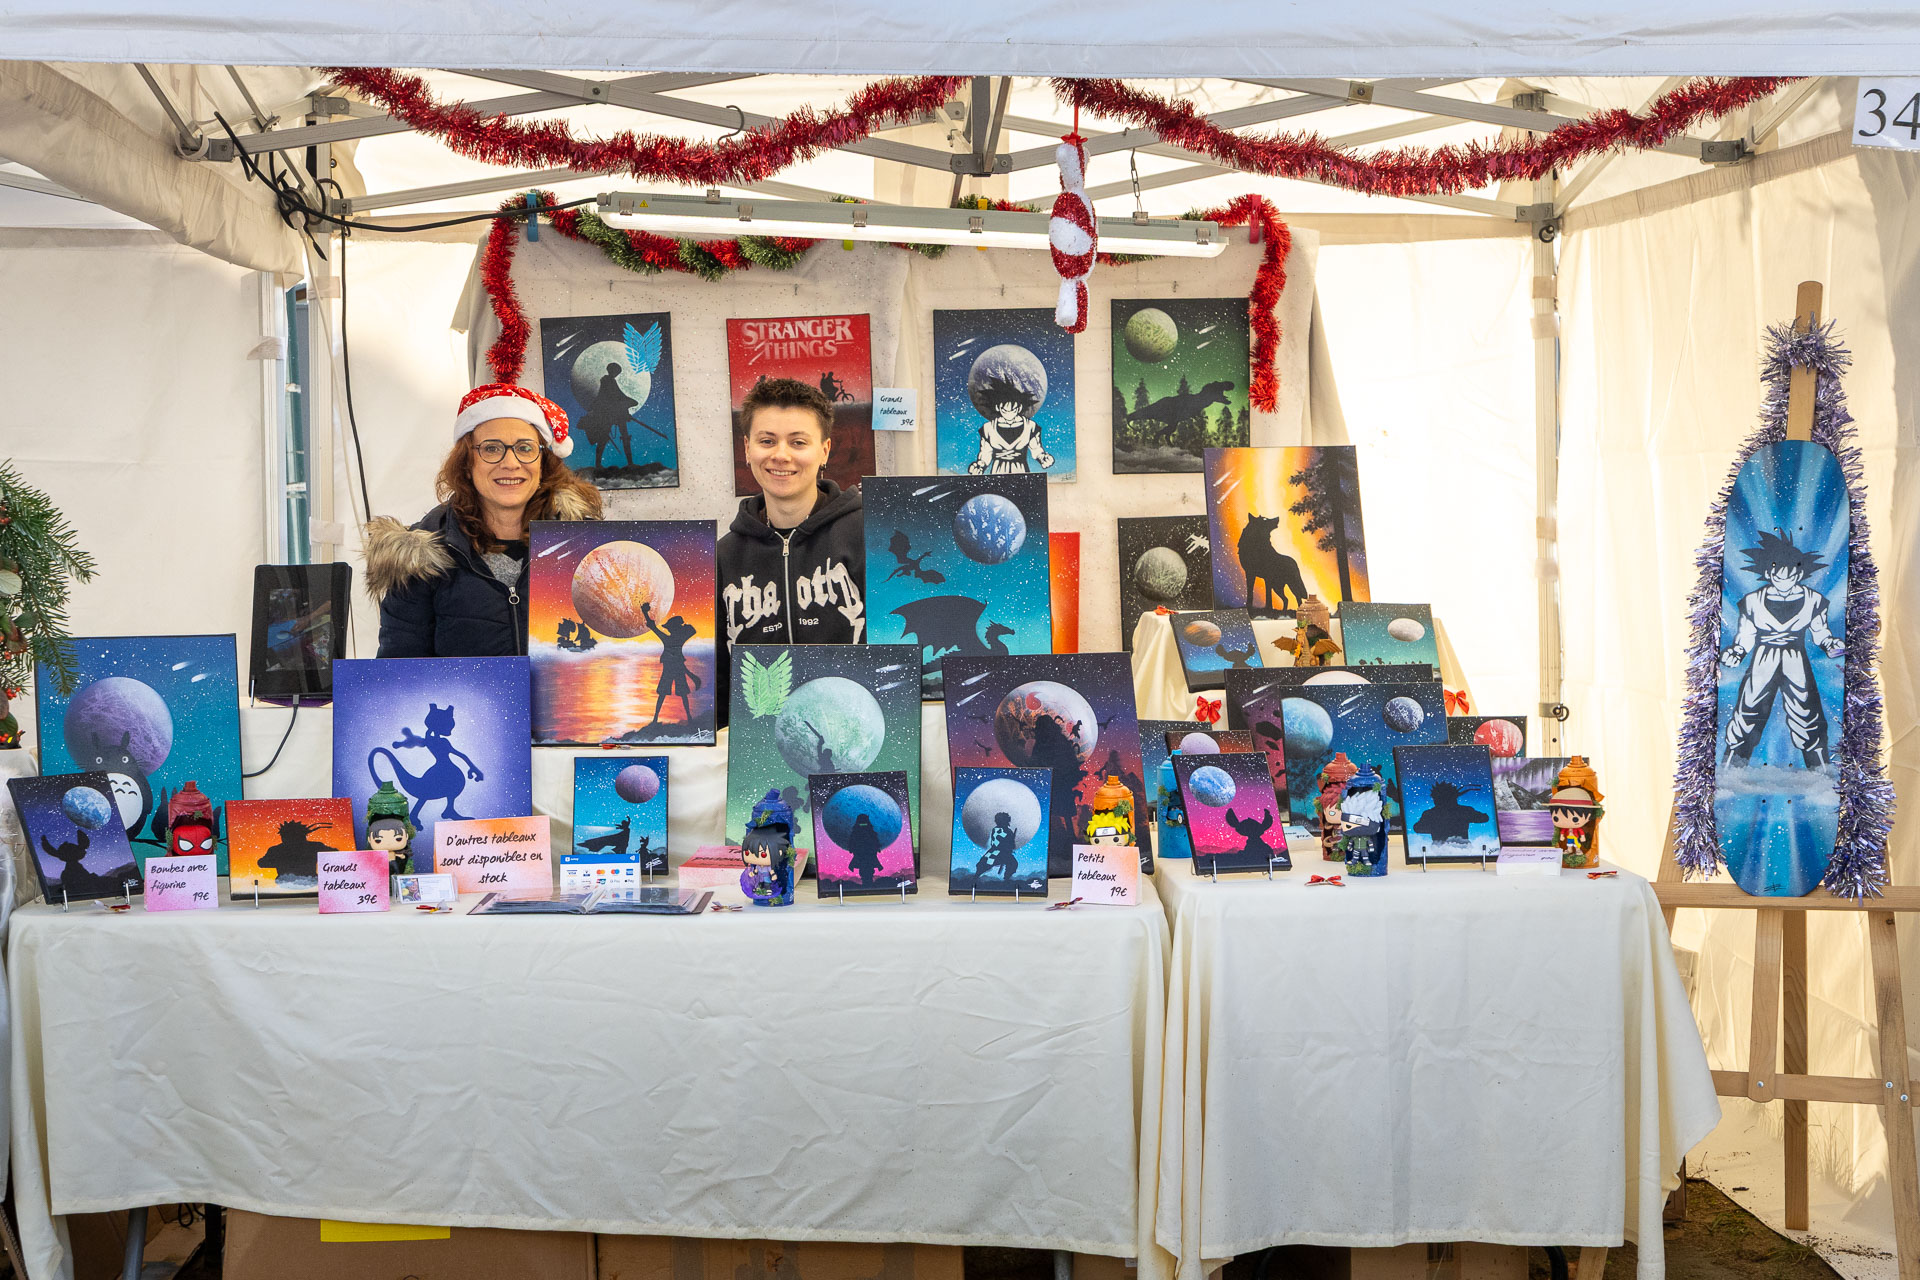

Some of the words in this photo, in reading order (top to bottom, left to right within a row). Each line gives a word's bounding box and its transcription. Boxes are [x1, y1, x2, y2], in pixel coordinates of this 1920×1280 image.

[1858, 88, 1920, 140] 34
[742, 318, 854, 346] STRANGER
[762, 339, 838, 360] THINGS
[880, 395, 903, 403] Grands
[880, 407, 908, 415] tableaux
[900, 418, 914, 426] 39€
[762, 622, 783, 634] ESTD
[798, 617, 820, 626] 1992
[446, 834, 489, 847] D'autres
[491, 830, 537, 845] tableaux
[440, 854, 465, 867] sont
[467, 850, 527, 868] disponibles
[530, 852, 544, 861] en
[1077, 852, 1105, 863] Petits
[150, 863, 185, 874] Bombes
[187, 864, 209, 873] avec
[322, 862, 358, 874] Grands
[478, 872, 509, 884] stock
[1077, 870, 1117, 882] tableaux
[150, 880, 187, 896] figurine
[323, 879, 367, 891] tableaux
[193, 891, 210, 902] 19€
[1110, 886, 1128, 897] 19€
[357, 894, 378, 905] 39€
